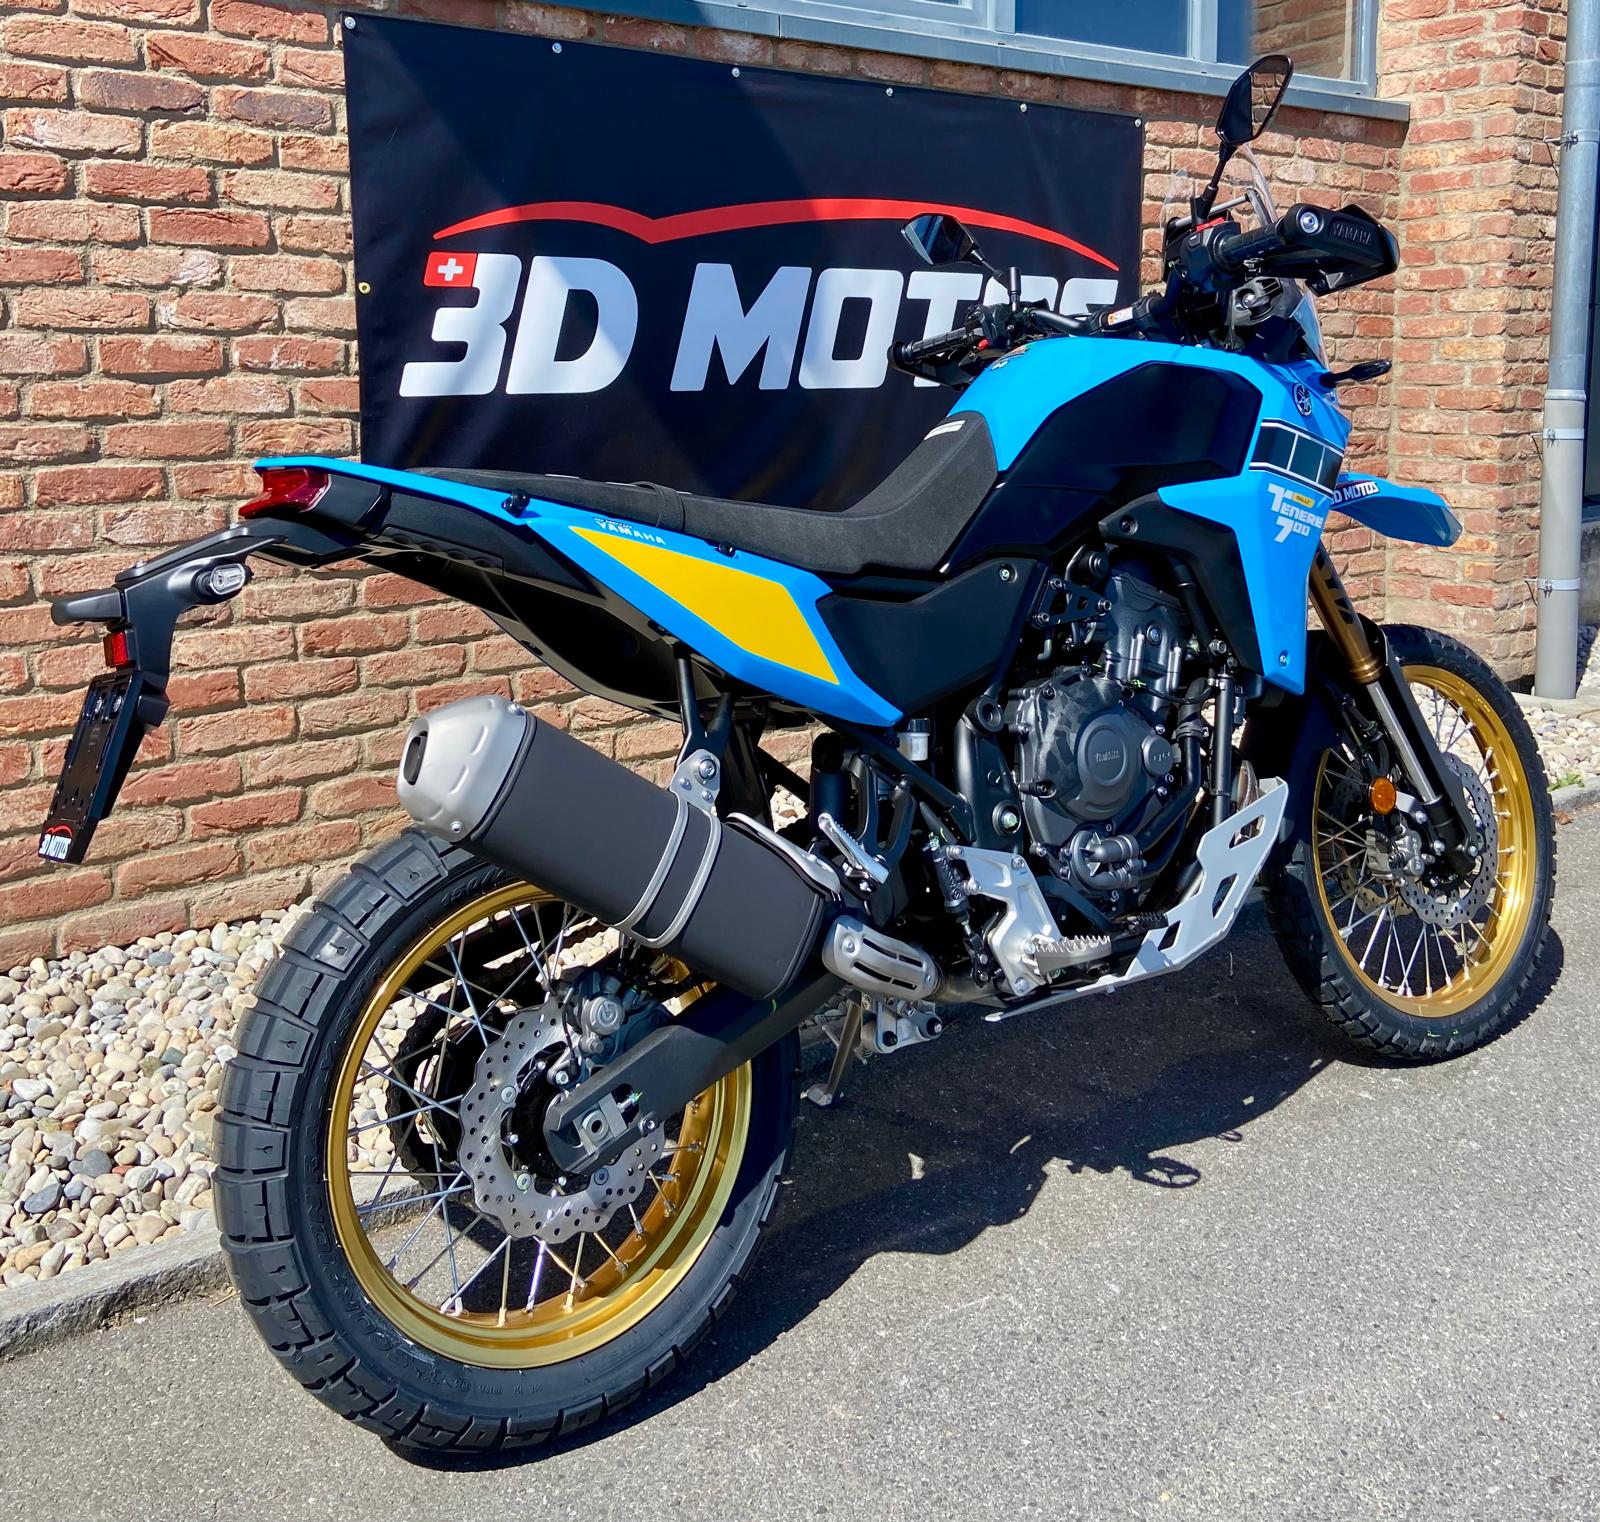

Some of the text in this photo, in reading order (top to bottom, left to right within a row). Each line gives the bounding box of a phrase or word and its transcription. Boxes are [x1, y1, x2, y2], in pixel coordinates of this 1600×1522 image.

[1333, 223, 1372, 246] YAMAHA
[399, 252, 1119, 397] 3D MOT
[1343, 481, 1380, 501] MOTOS
[595, 520, 667, 546] YAMAHA
[1274, 515, 1311, 544] 700
